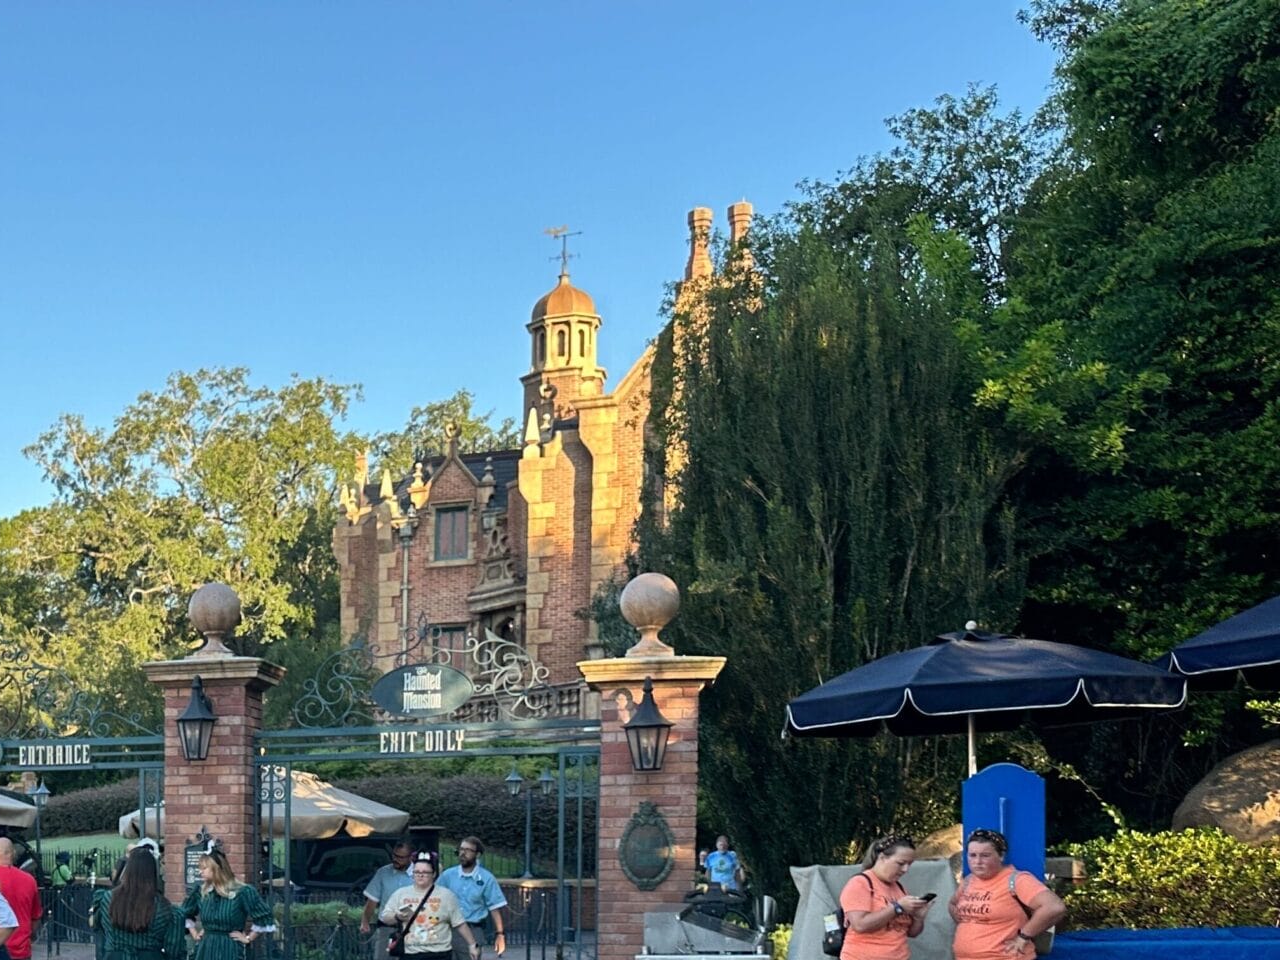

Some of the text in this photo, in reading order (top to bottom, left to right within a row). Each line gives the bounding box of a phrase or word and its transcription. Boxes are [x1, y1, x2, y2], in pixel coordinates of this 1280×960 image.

[403, 670, 442, 691] Haunted
[402, 691, 442, 713] Mansion
[380, 729, 465, 753] EXIT ONLY
[19, 744, 91, 766] ENTRANCE
